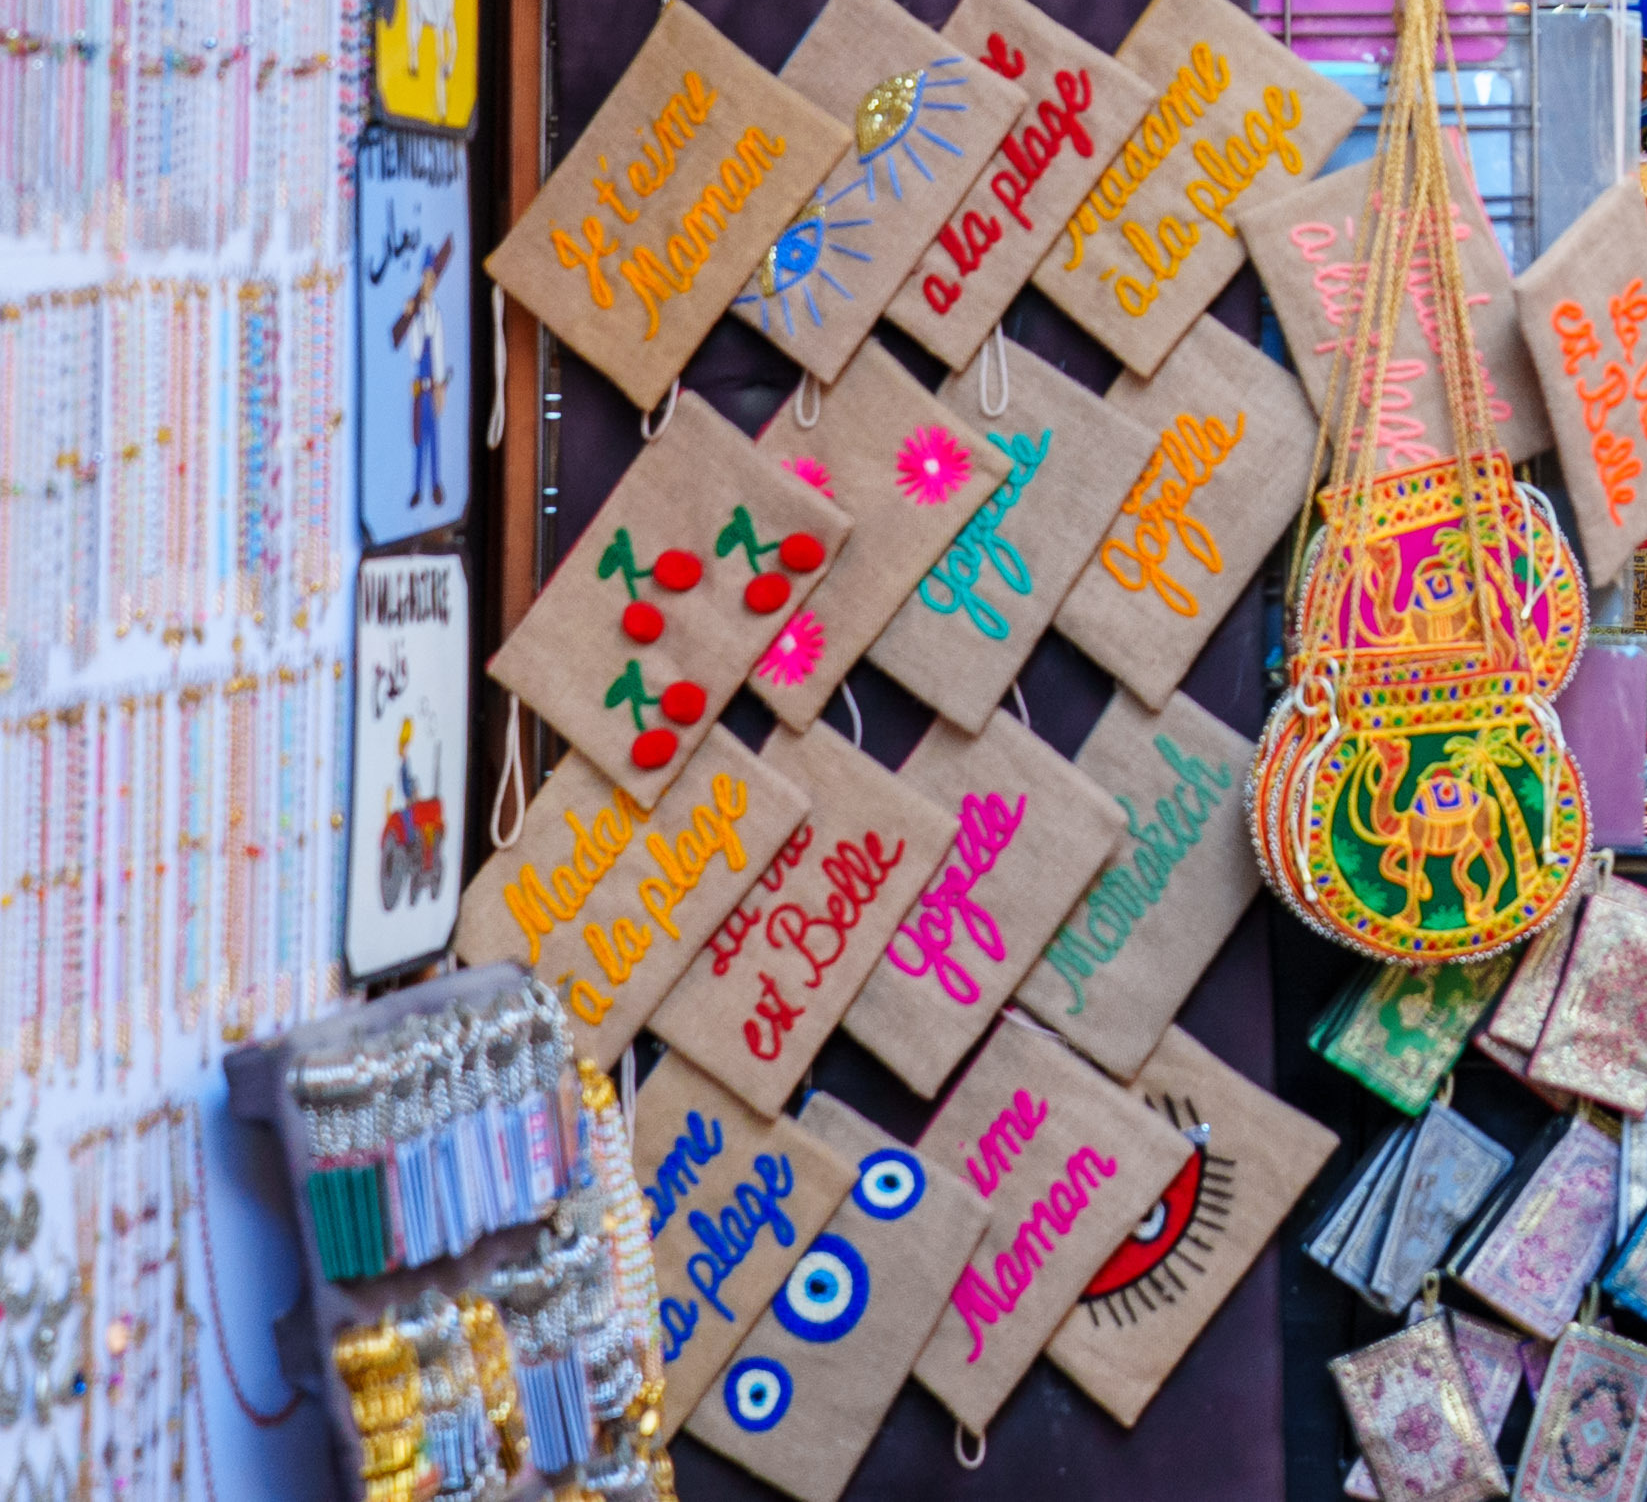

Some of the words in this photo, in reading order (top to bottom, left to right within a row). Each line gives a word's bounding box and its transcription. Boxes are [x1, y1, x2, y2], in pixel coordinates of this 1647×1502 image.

[549, 215, 620, 310] Je
[591, 69, 719, 225] t'aime
[619, 124, 787, 342] Maman
[938, 209, 1003, 278] la
[991, 67, 1095, 232] plage
[1121, 215, 1200, 282] la
[1185, 85, 1303, 240] plage
[583, 917, 654, 987] la
[637, 773, 749, 942] plage
[765, 830, 906, 990] Belle
[741, 971, 806, 1062] est
[686, 1152, 797, 1324] plage
[949, 1145, 1118, 1366] Maman
